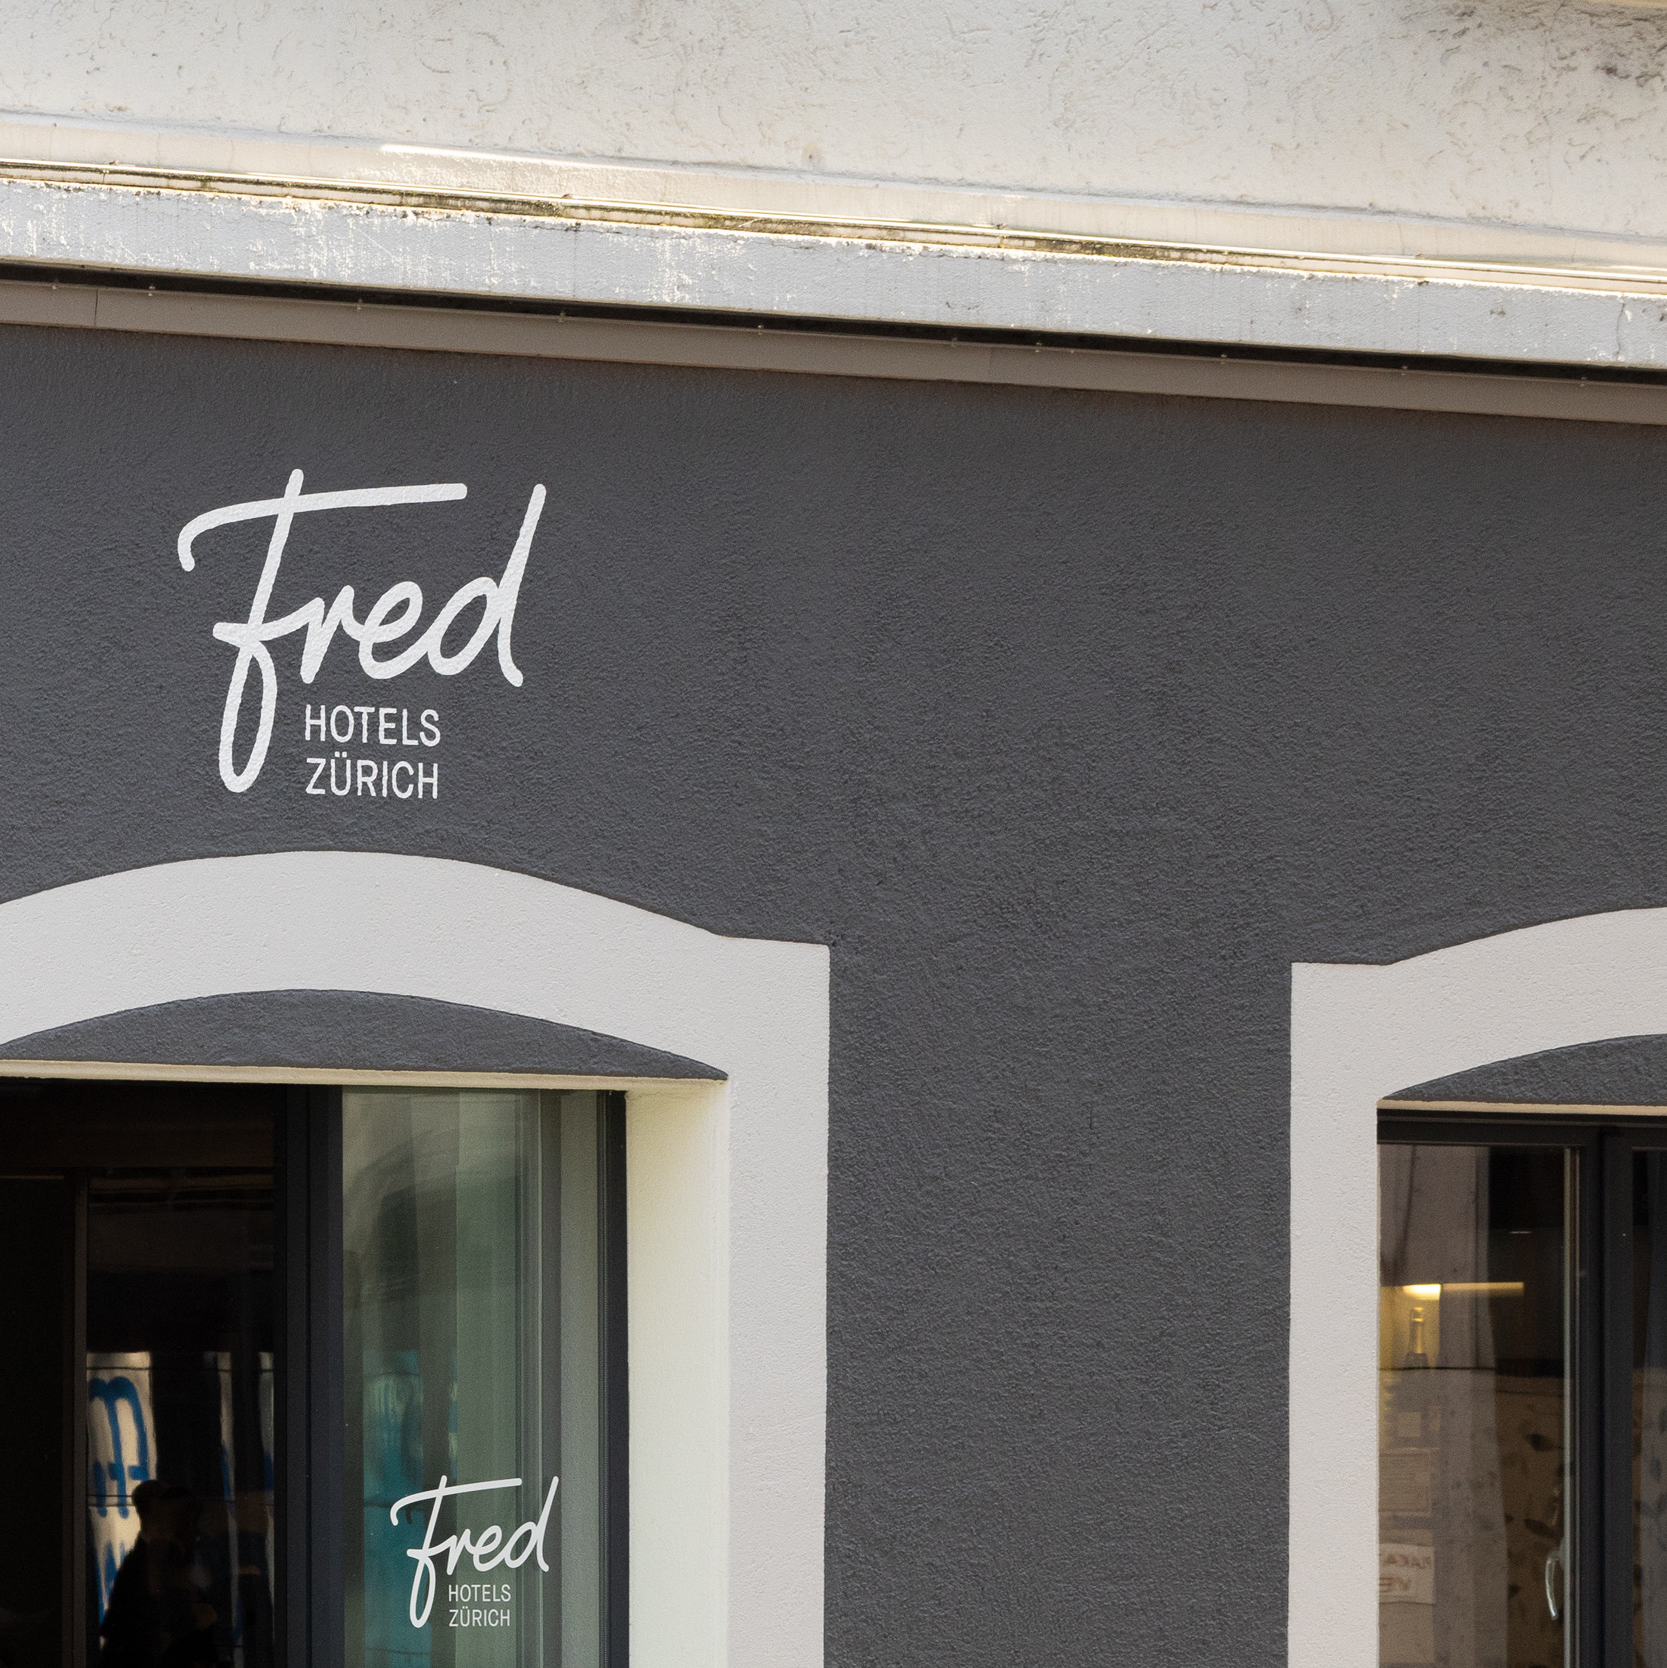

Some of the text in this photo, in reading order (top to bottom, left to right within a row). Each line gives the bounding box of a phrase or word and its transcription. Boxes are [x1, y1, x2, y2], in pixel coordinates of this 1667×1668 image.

[177, 469, 546, 793] Fred
[305, 704, 441, 748] HOTELS
[305, 751, 440, 800] ZÜRICH
[389, 1474, 559, 1629] Fred
[448, 1583, 512, 1603] HOTELS
[448, 1605, 512, 1628] ZÜRICH
